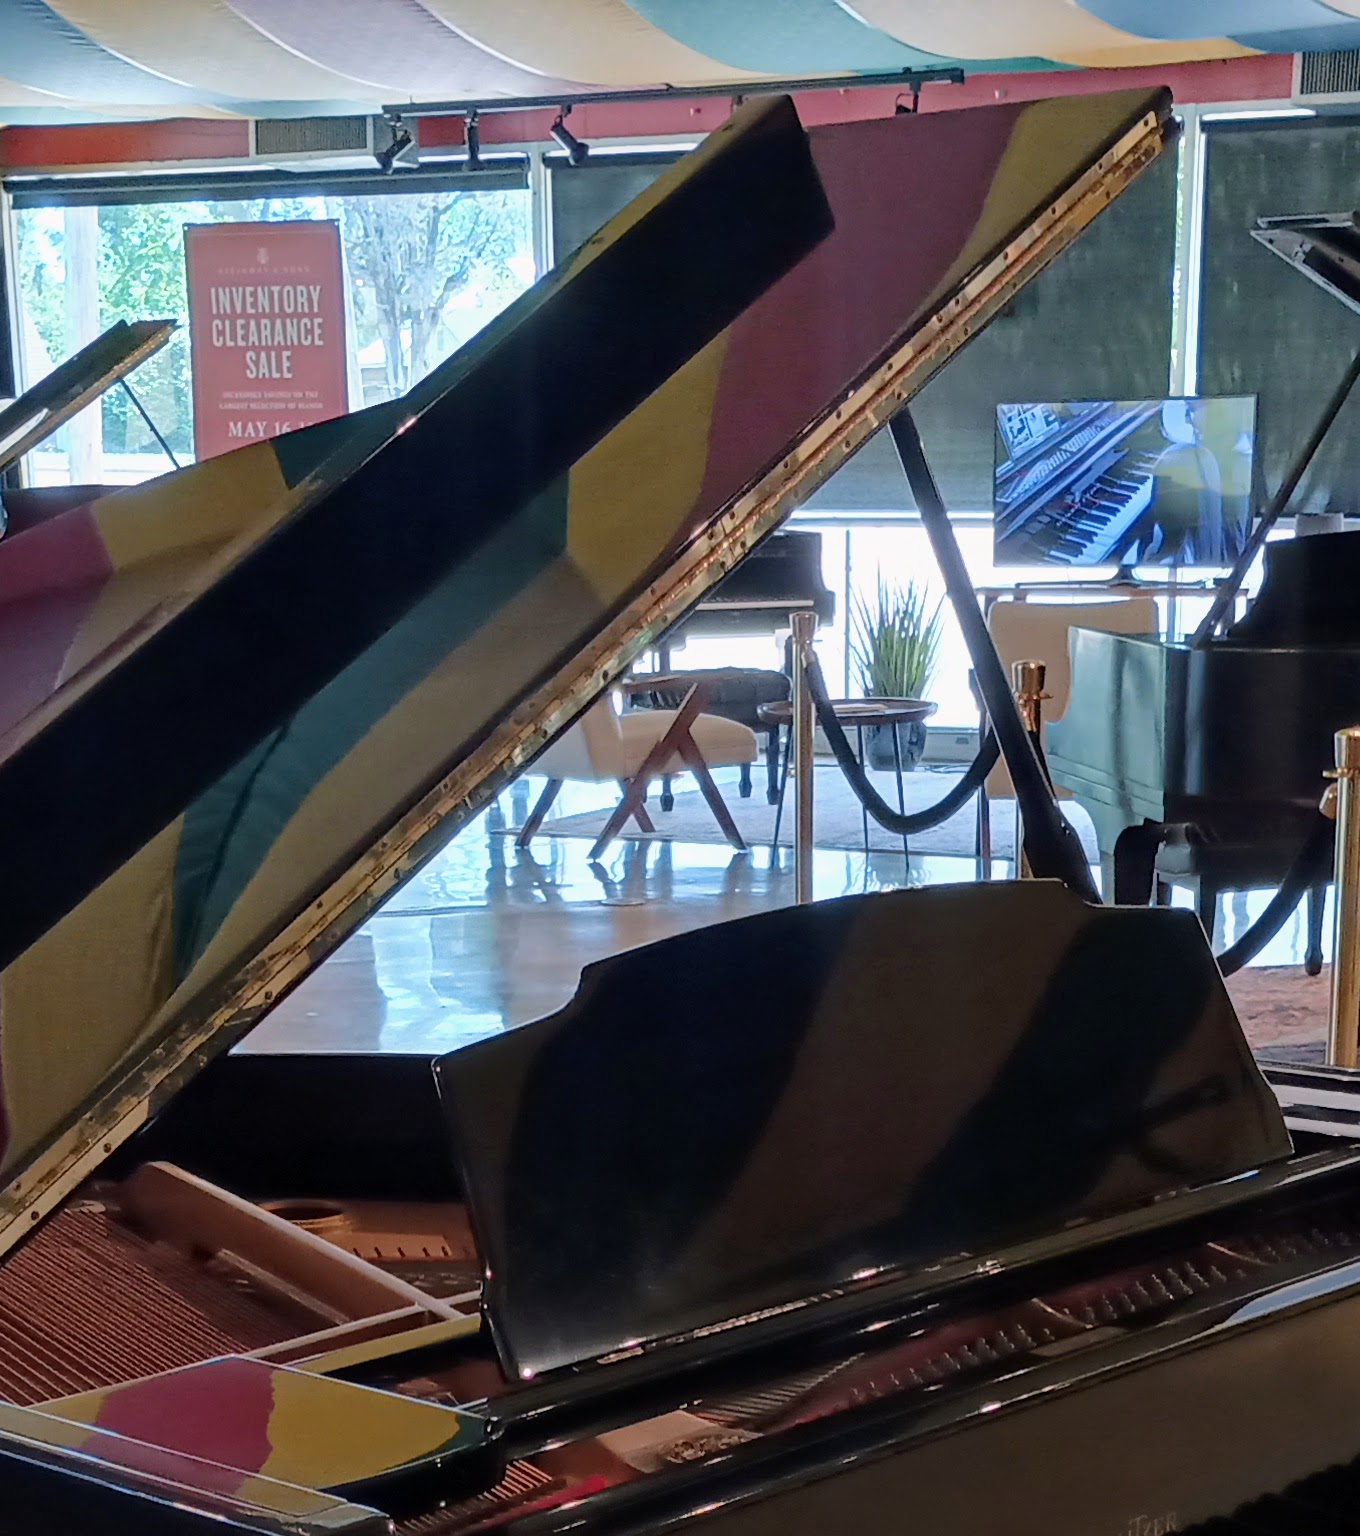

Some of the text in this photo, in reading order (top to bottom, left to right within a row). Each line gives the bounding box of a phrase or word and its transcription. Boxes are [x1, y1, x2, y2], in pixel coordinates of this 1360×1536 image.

[210, 285, 321, 315] INVENTORY
[212, 317, 324, 347] CLEARANCE
[246, 350, 293, 379] SALE
[228, 421, 267, 437] MAY
